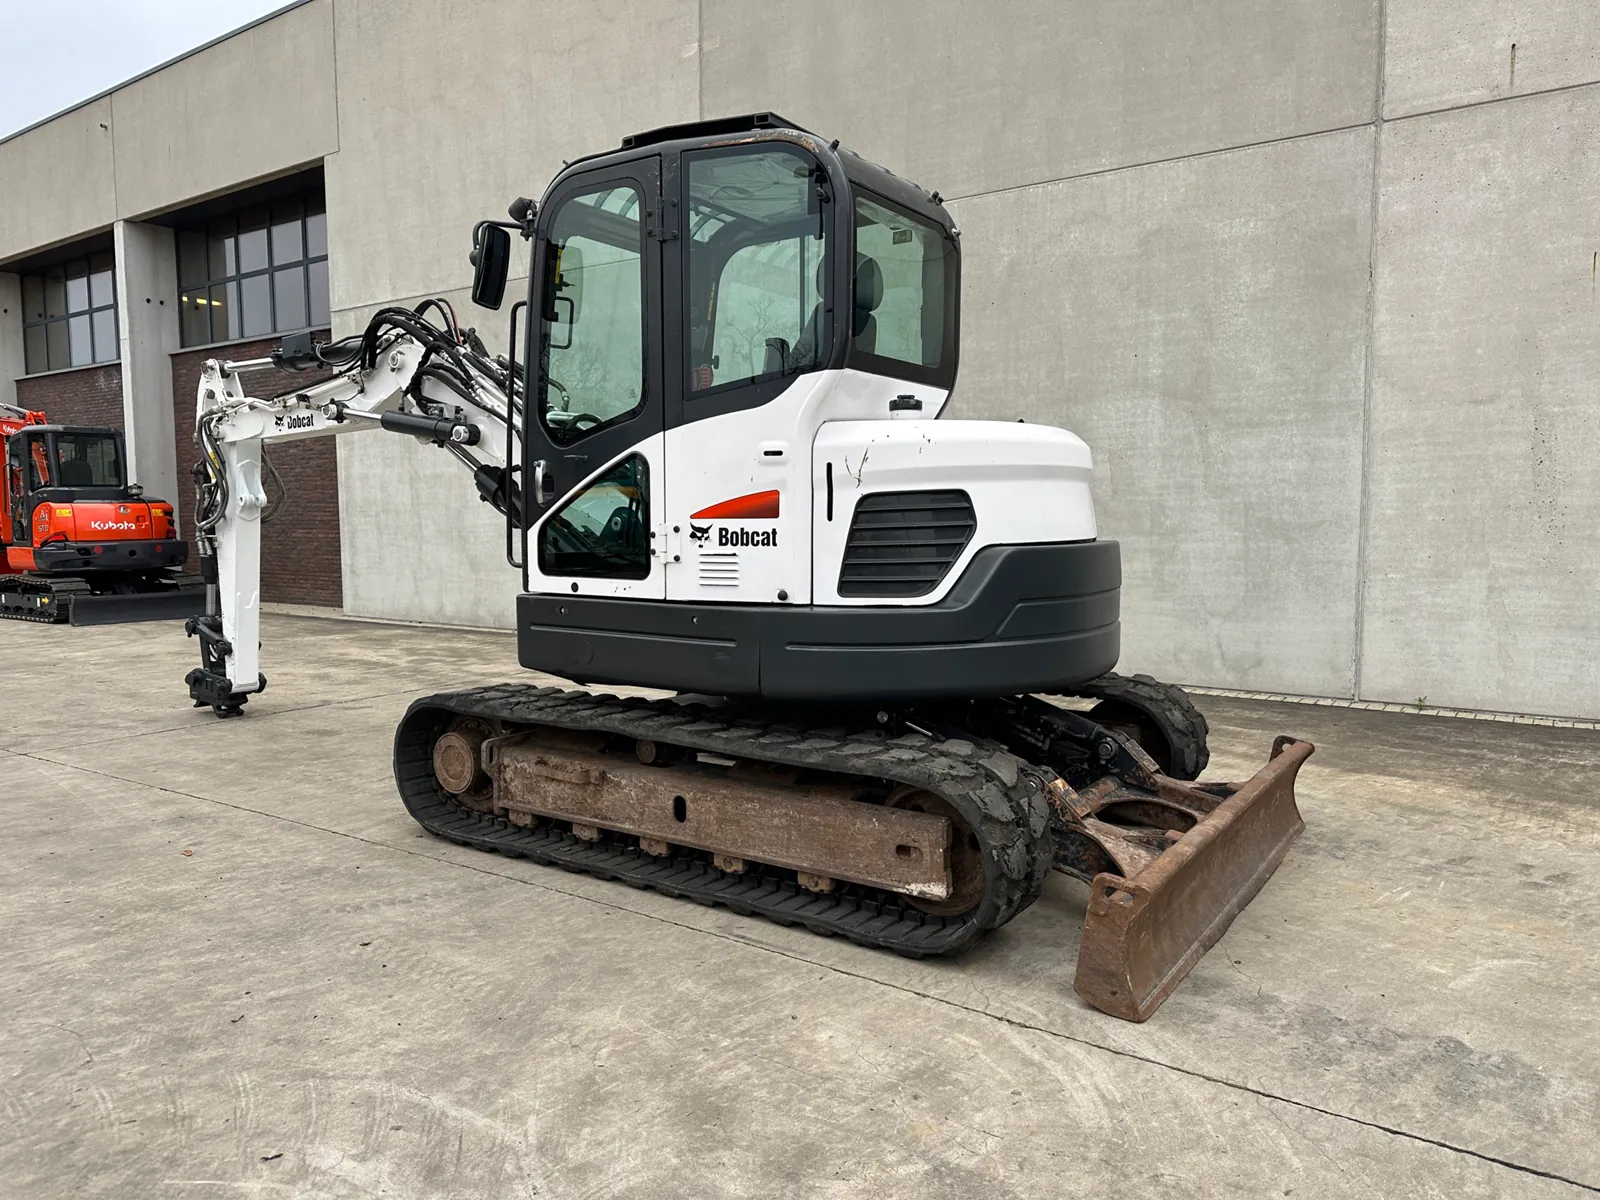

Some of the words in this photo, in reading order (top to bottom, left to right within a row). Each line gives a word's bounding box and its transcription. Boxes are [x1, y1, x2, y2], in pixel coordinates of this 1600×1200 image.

[287, 414, 315, 429] Bobcat
[91, 520, 136, 530] Kubota
[718, 527, 778, 547] Bobcat
